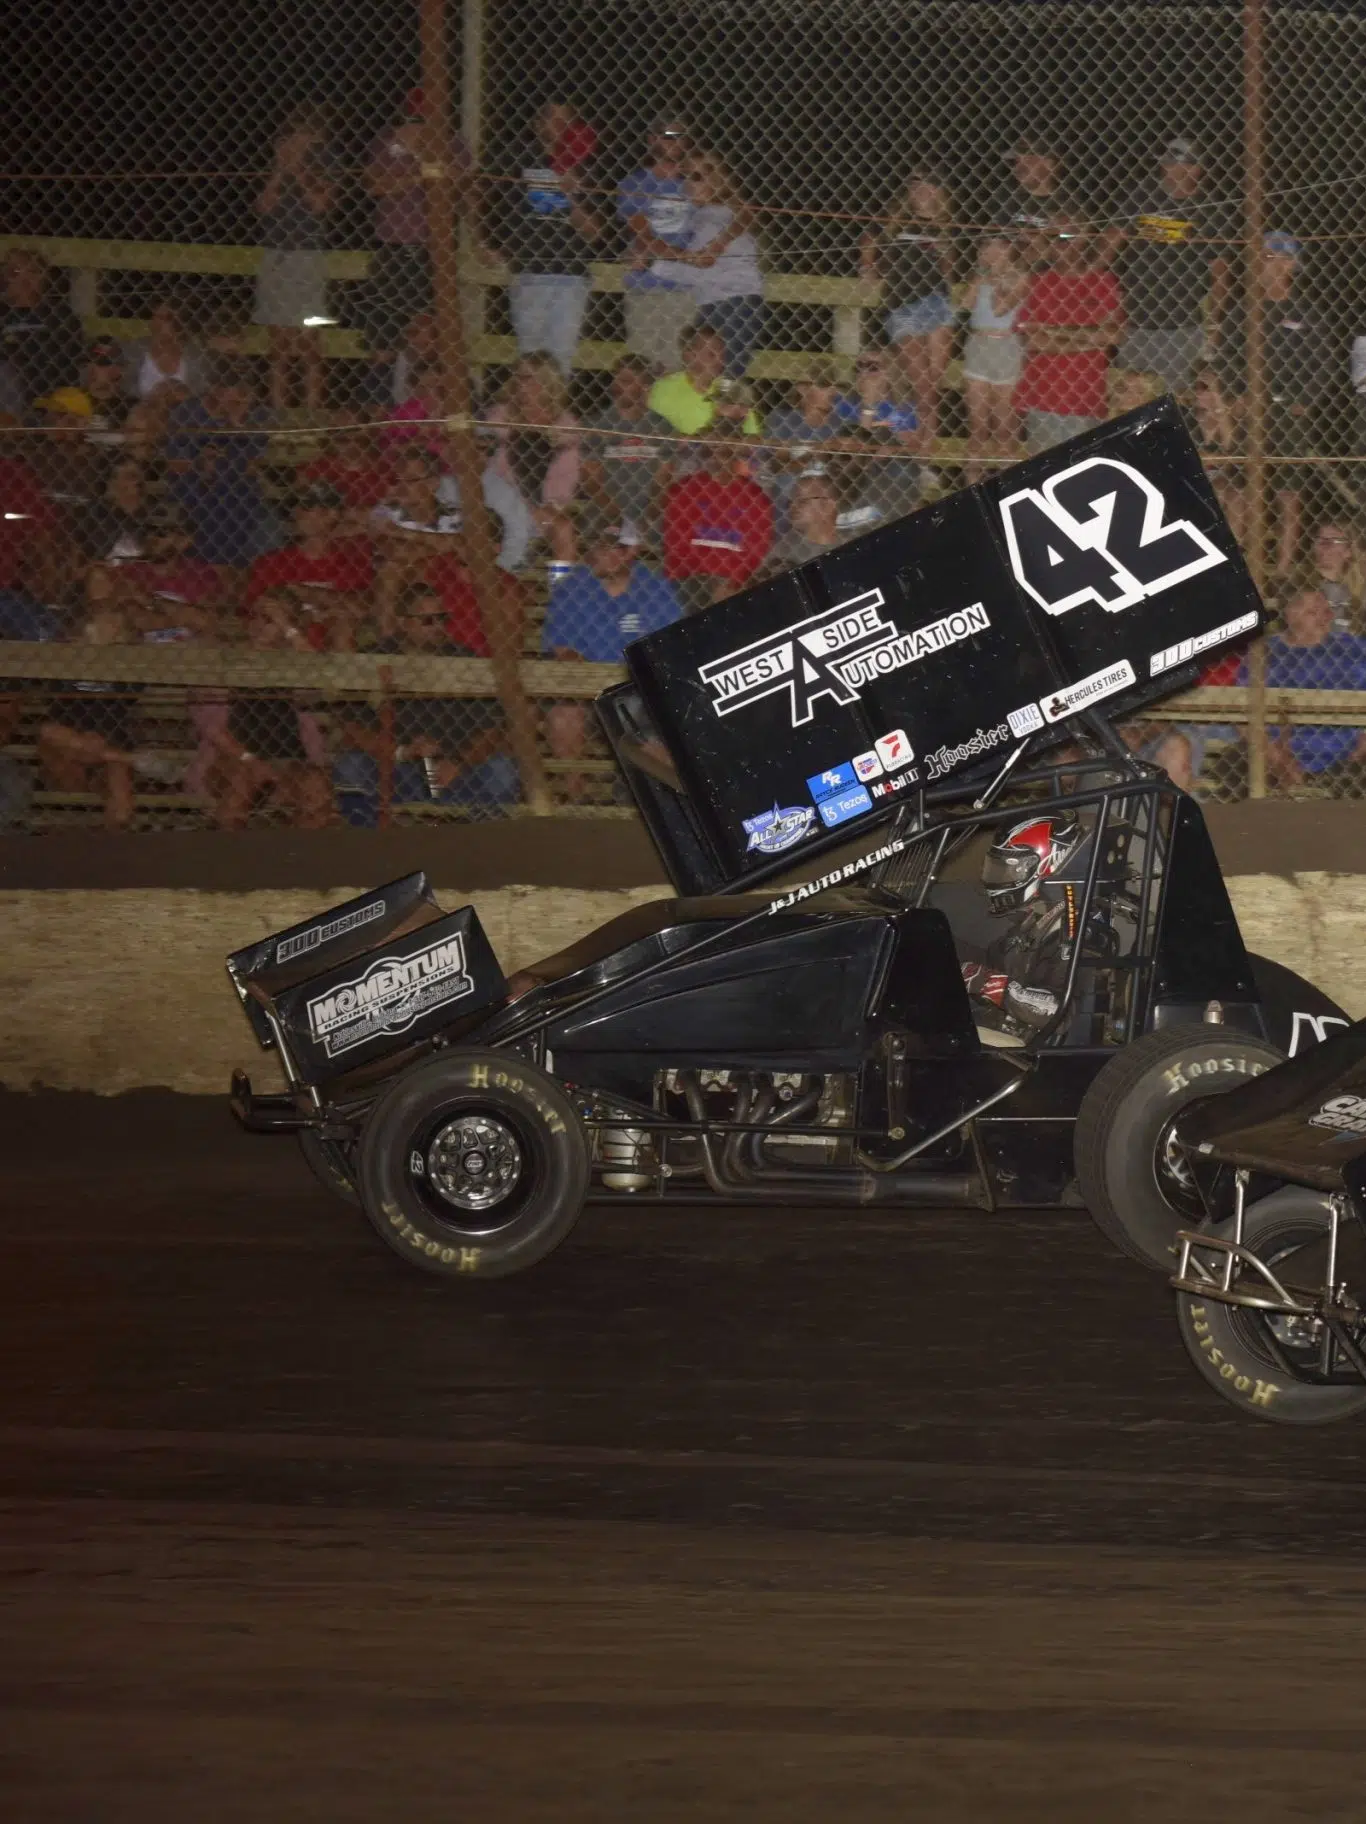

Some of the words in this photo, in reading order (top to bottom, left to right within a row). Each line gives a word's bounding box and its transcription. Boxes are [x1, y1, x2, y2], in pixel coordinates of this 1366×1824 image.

[999, 457, 1228, 616] 42
[714, 649, 785, 696] WEST
[822, 608, 880, 649] SIDE
[790, 602, 991, 728] AUTOMATION
[1150, 637, 1194, 676] 300
[1193, 610, 1258, 654] CUSTOMS
[1007, 704, 1041, 730] DIXIE
[1064, 679, 1103, 706] HERCULES
[1103, 667, 1128, 687] TIRES
[924, 723, 1009, 781] Hoosier
[838, 793, 869, 812] Tezos
[871, 773, 907, 799] Mobil
[748, 828, 774, 847] ALL
[786, 807, 816, 831] STAR
[768, 891, 796, 916] J&J
[797, 869, 842, 902] AUTO
[843, 838, 905, 878] RACING
[277, 925, 321, 964] 300
[320, 900, 386, 943] CUSTOMS
[313, 939, 461, 1027] MOMENTUM
[323, 1004, 369, 1030] RACING
[371, 965, 455, 1008] SUSPENSIONS
[381, 1202, 483, 1273] Hoosier
[1190, 1303, 1285, 1408] Hoosier
